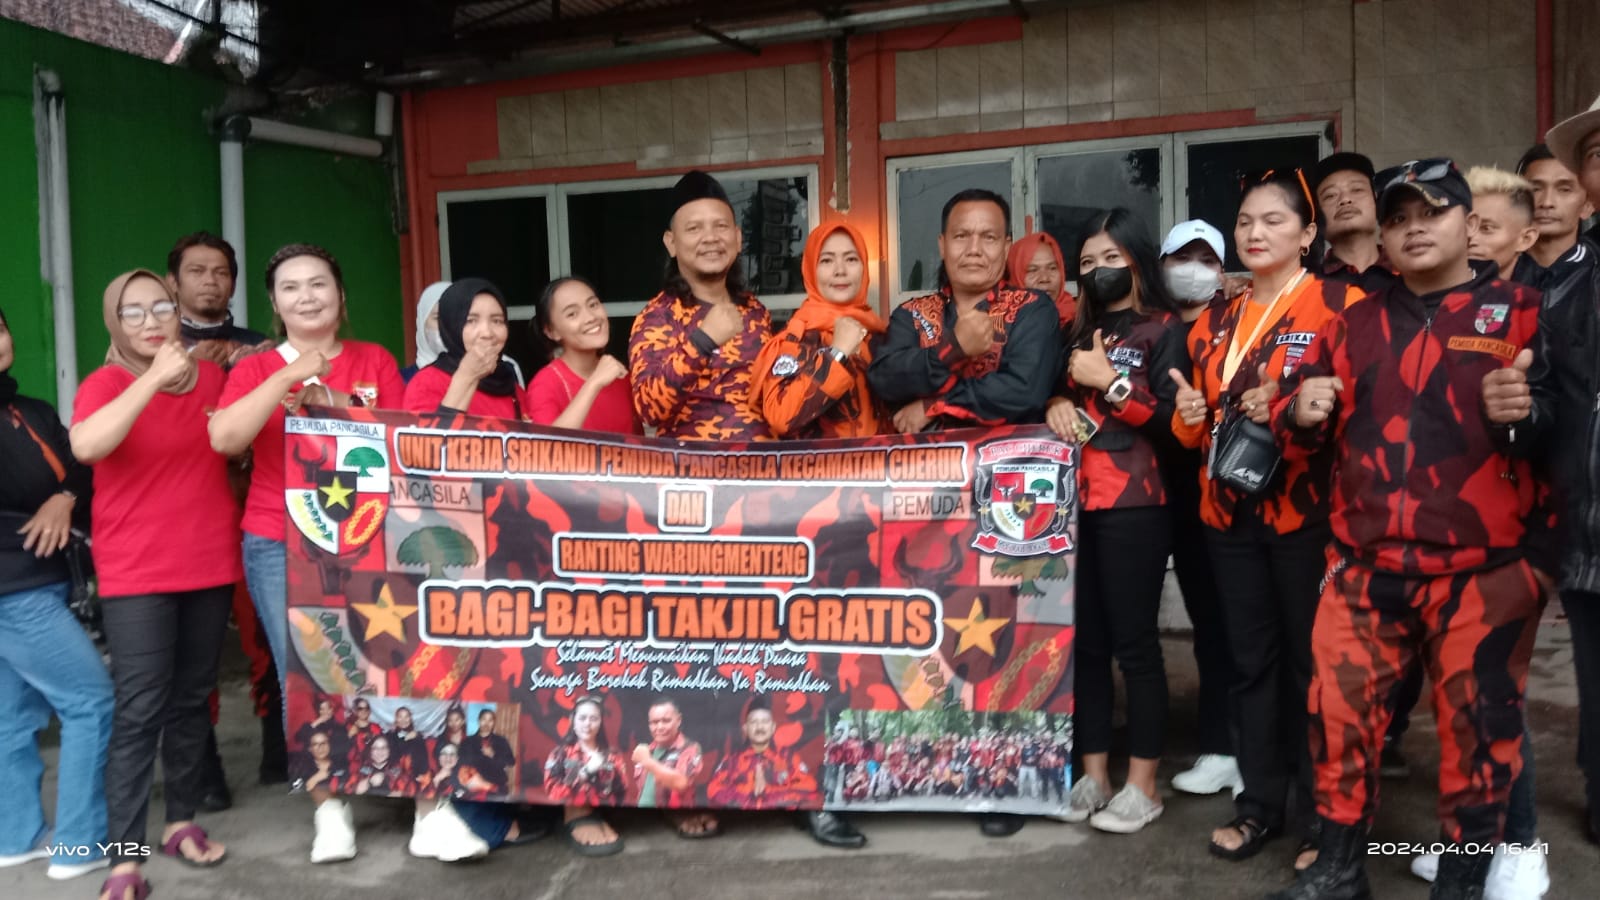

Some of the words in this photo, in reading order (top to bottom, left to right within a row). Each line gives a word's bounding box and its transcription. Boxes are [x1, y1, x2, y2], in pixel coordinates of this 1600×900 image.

[289, 419, 328, 433] PEMUDA
[330, 421, 380, 436] PANCASILA
[401, 434, 443, 470] UNIT
[447, 436, 504, 471] KERJA
[507, 437, 597, 474] SRIKANDI
[600, 445, 675, 477] PEMUDA
[679, 453, 778, 480] PANCASILA
[781, 450, 886, 481] KECAMATAN
[889, 447, 965, 482] CIJERUK
[390, 480, 471, 506] ANCASILA
[665, 491, 705, 526] DAN
[892, 493, 966, 516] PEMUDA
[560, 539, 640, 573] RANTING
[643, 541, 807, 576] WARUNGMENTENG
[429, 590, 644, 637] BAGI-BAGI
[652, 596, 780, 640] TAKJIL
[788, 597, 932, 645] GRATIS
[556, 640, 616, 665] Selamat
[617, 641, 710, 665] Menunaikan
[763, 645, 807, 669] Puasa
[530, 666, 584, 696] Semoga
[586, 665, 649, 690] Barokah
[651, 667, 729, 692] Ramadhan
[731, 669, 751, 693] Ya
[753, 669, 832, 694] Ramadhan
